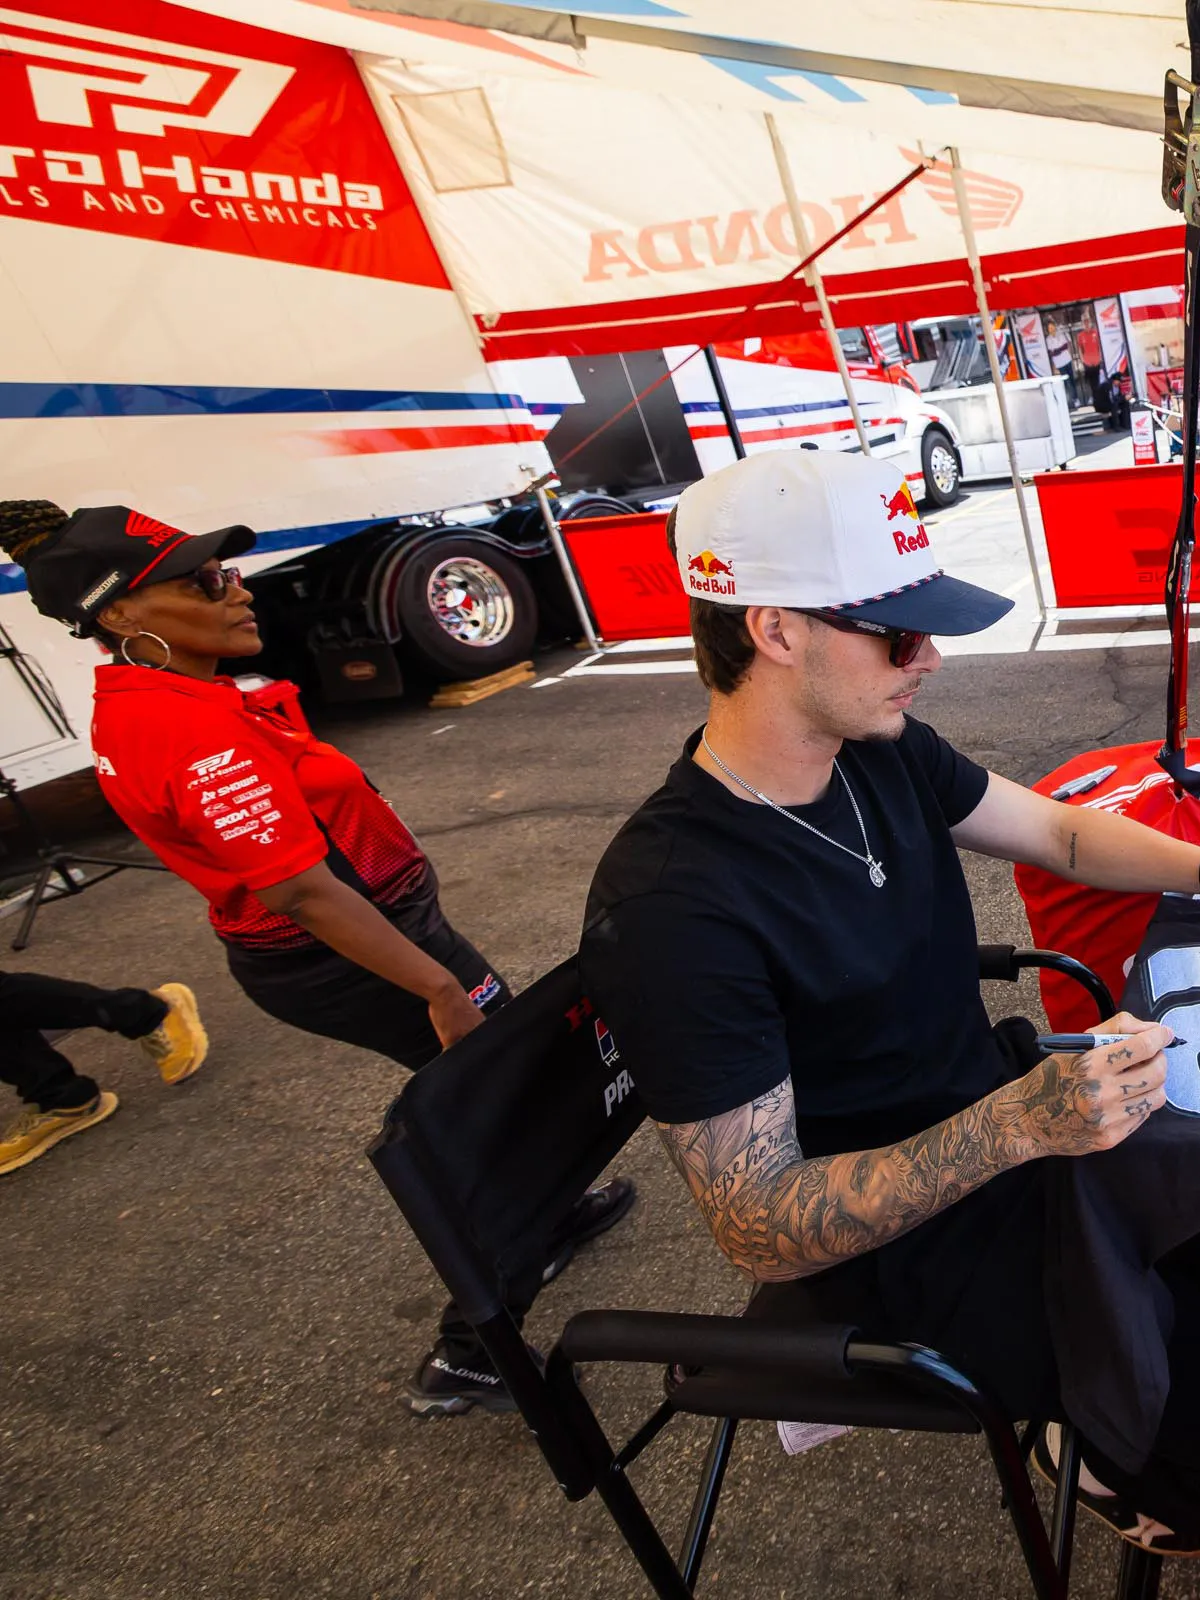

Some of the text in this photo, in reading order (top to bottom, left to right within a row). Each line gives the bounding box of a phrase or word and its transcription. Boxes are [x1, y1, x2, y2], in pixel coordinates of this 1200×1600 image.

[83, 190, 165, 215] AND
[190, 199, 377, 231] CHEMICALS
[690, 574, 709, 592] Red
[711, 578, 736, 595] Bull
[217, 775, 260, 797] SHOWA
